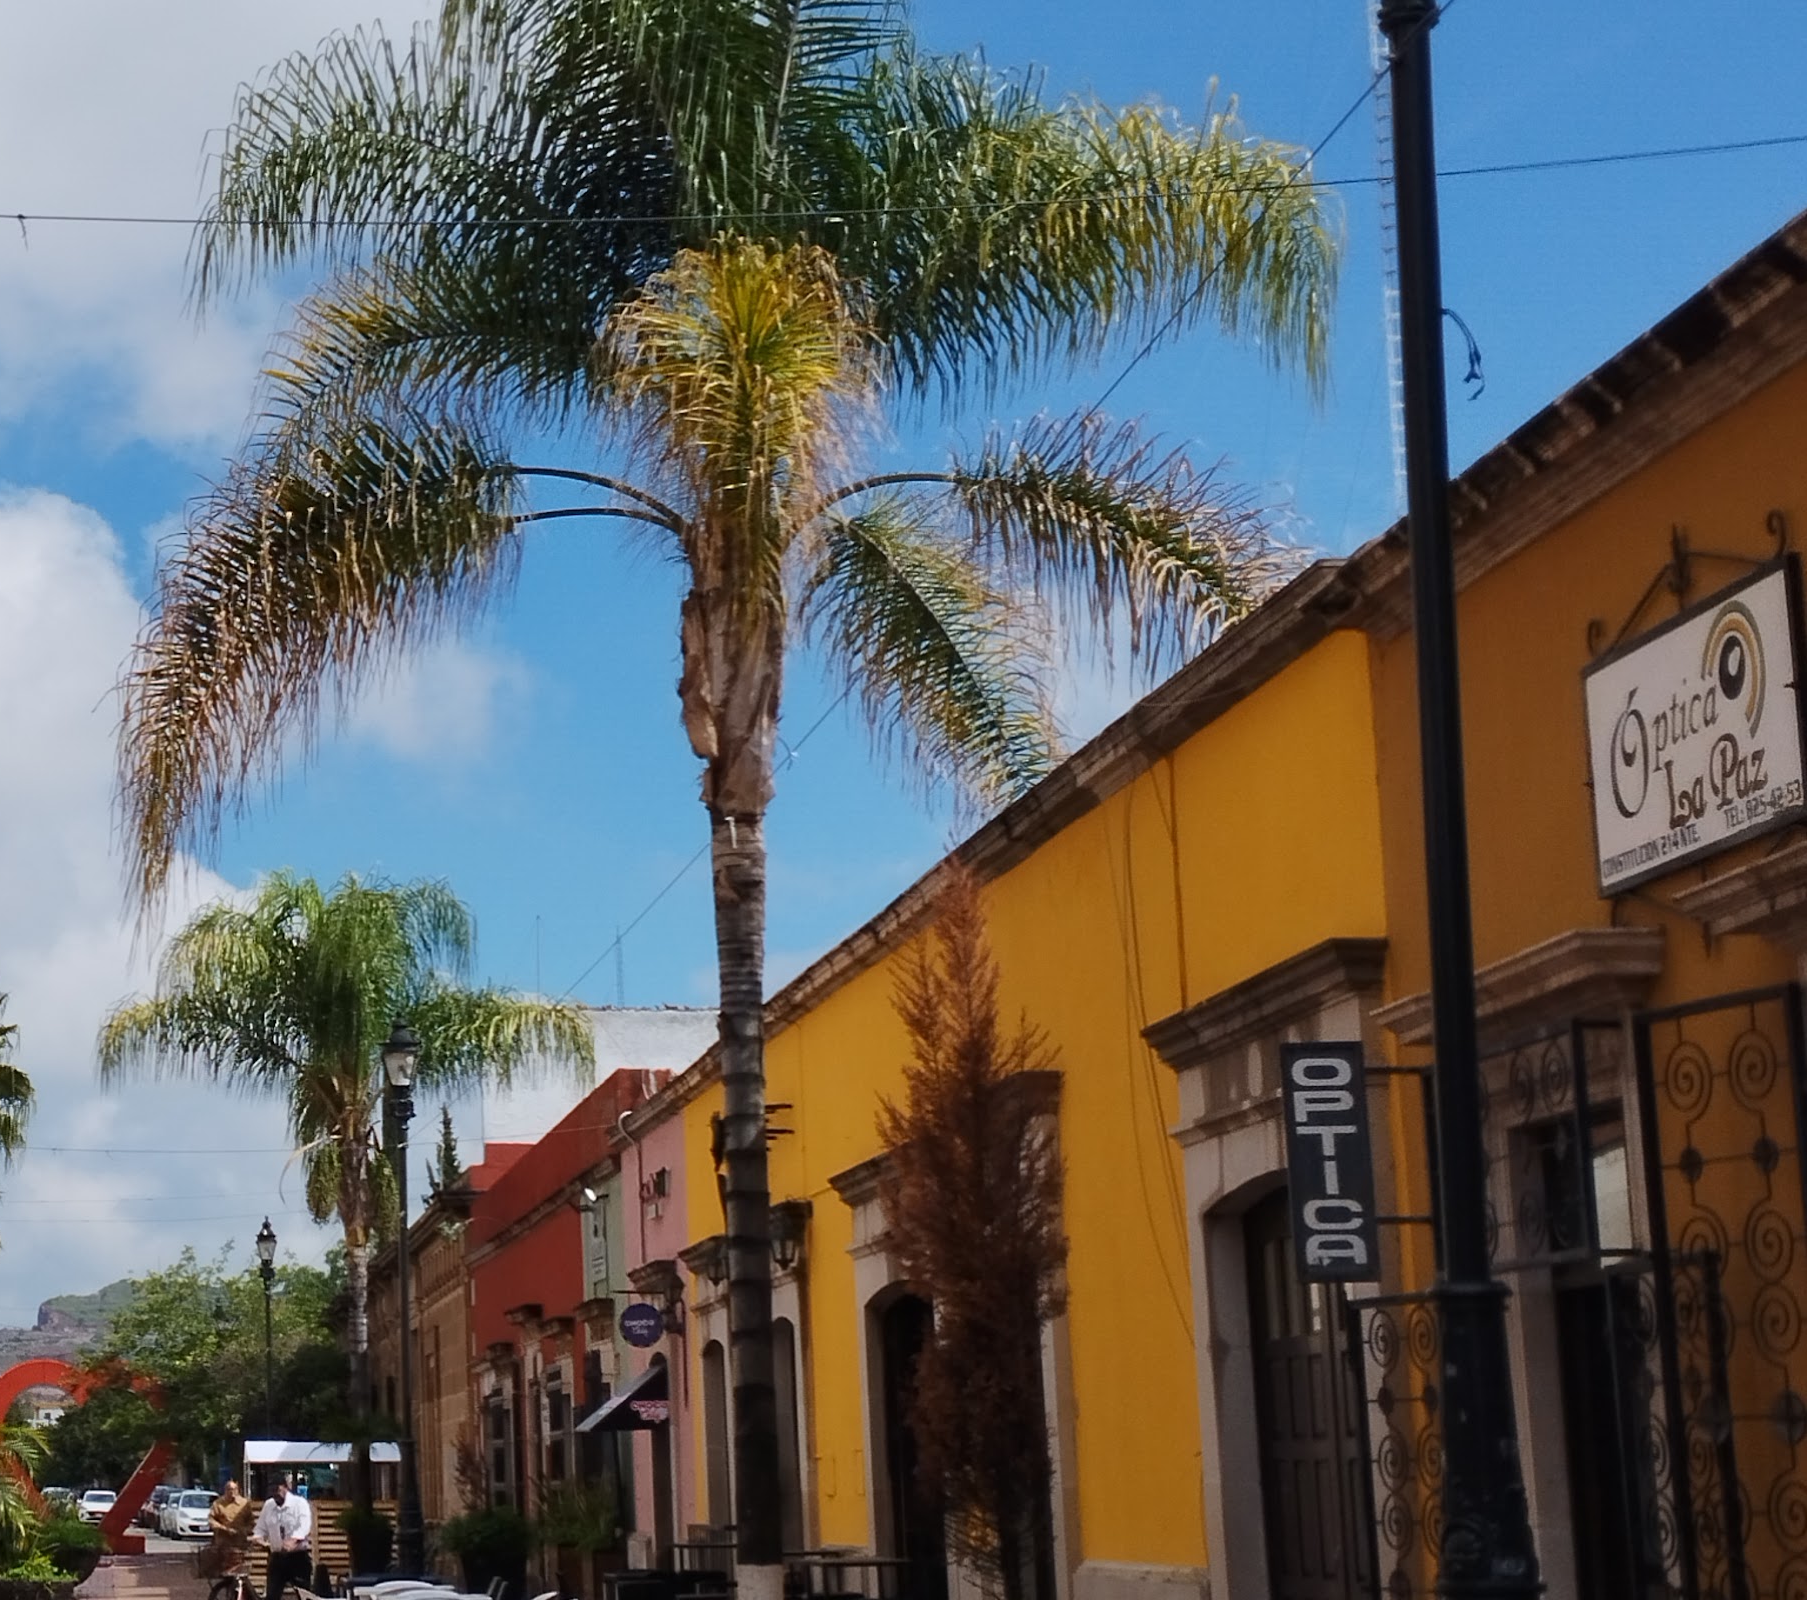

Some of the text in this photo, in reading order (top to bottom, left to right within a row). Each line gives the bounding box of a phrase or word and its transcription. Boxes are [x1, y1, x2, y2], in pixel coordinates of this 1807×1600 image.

[1609, 678, 1719, 819] Óptica
[1665, 732, 1769, 831] La Paz
[1291, 1057, 1368, 1266] OPTICA
